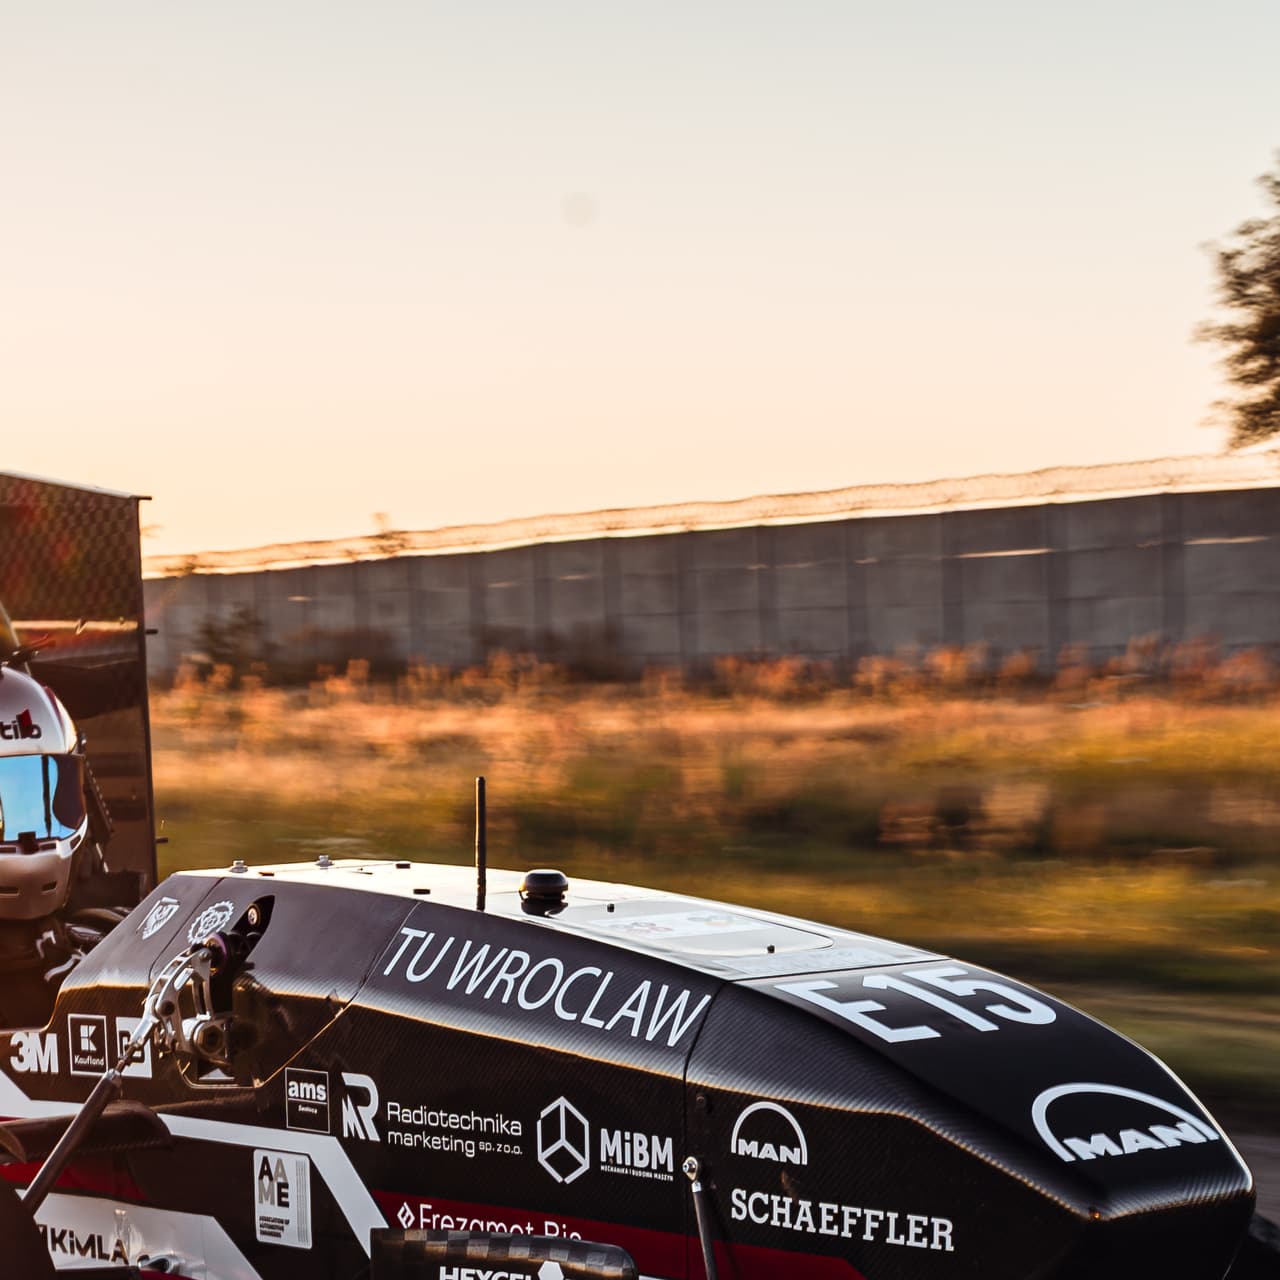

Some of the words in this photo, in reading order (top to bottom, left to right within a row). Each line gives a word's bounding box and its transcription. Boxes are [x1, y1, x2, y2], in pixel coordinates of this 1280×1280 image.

[383, 926, 455, 983] TU
[446, 939, 711, 1047] WROCLAW
[774, 965, 1057, 1043] E15
[10, 1031, 59, 1074] 3M
[74, 1055, 105, 1067] Kaufland
[288, 1081, 327, 1101] ams
[387, 1101, 522, 1136] Radiotechnika
[388, 1130, 476, 1157] marketing
[601, 1128, 673, 1172] MiBM
[738, 1139, 802, 1164] MAN
[1065, 1121, 1211, 1161] MAN
[731, 1187, 954, 1252] SCHAEFFLER
